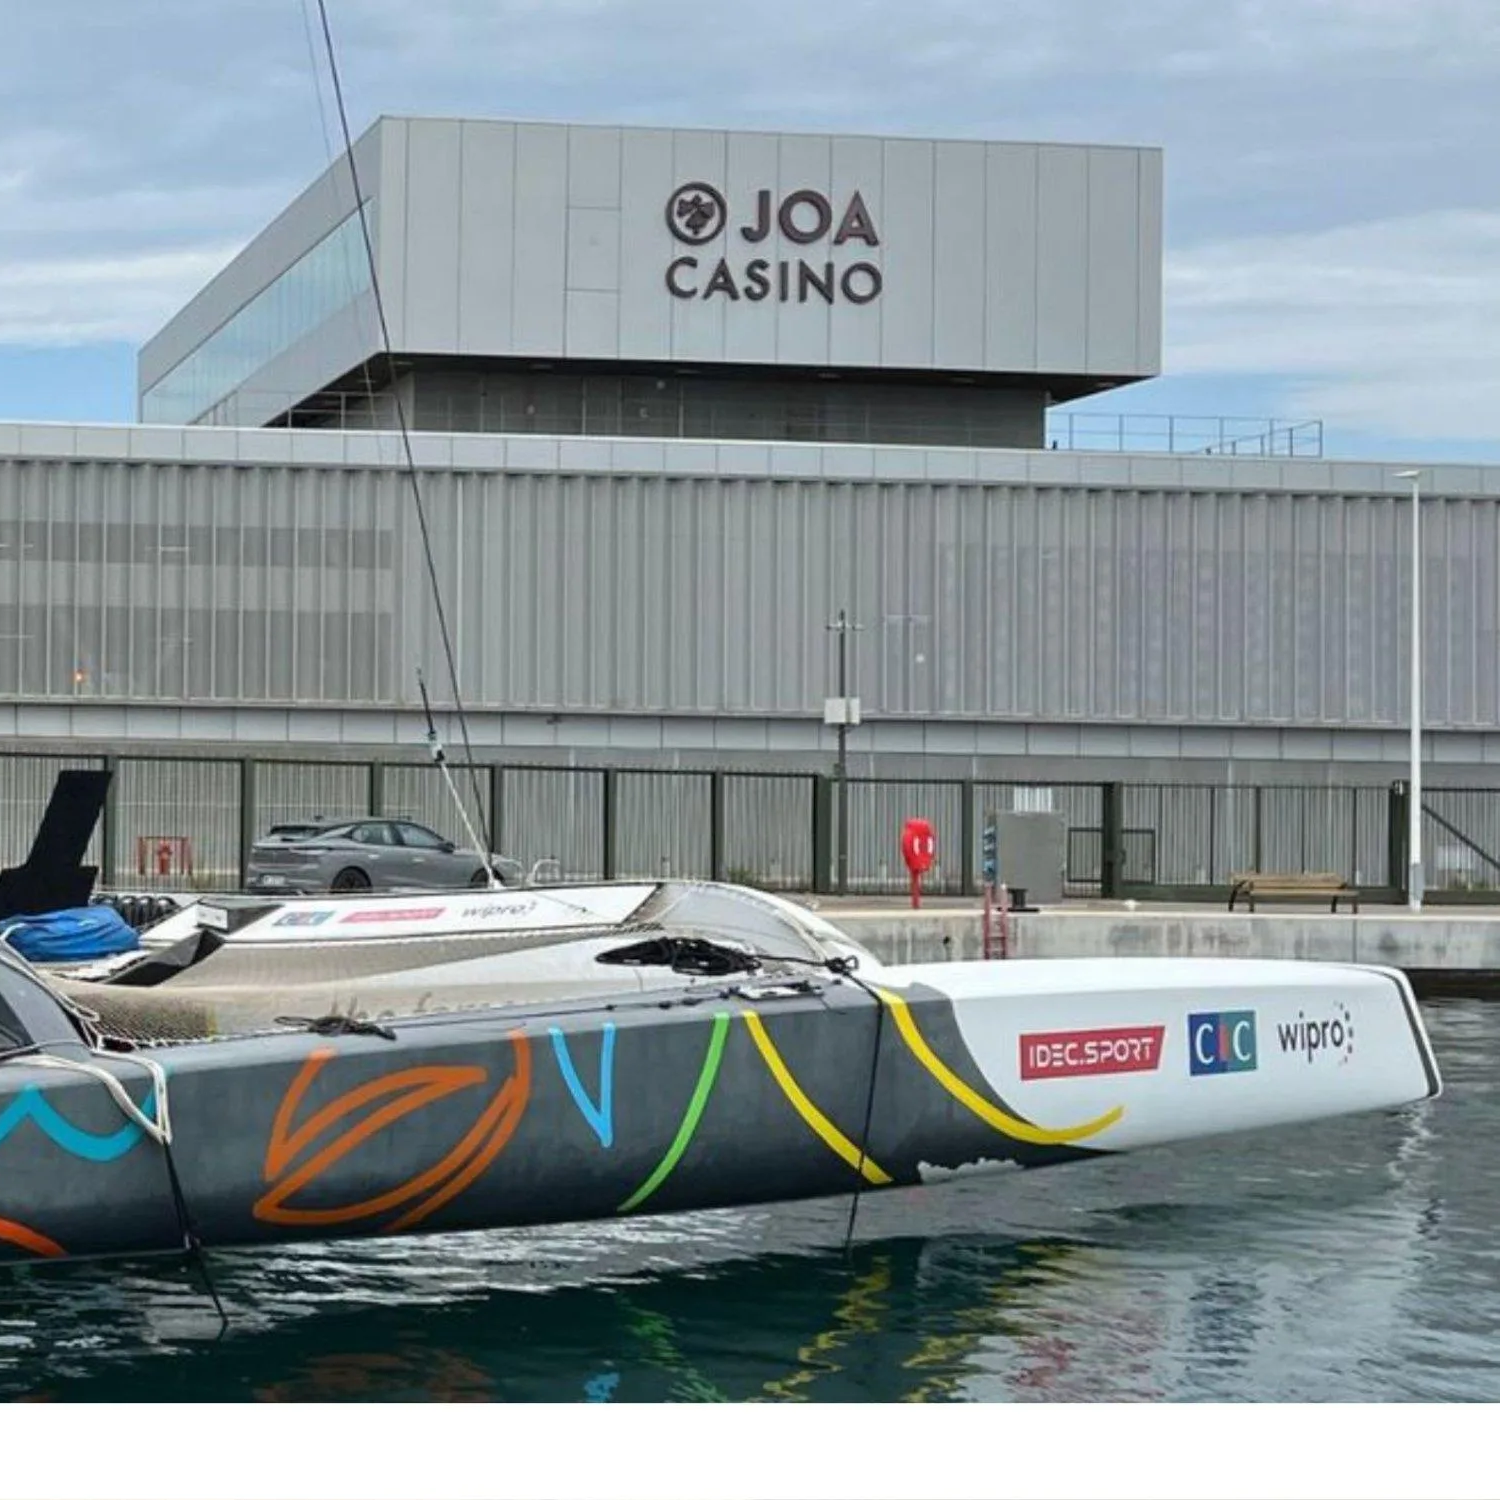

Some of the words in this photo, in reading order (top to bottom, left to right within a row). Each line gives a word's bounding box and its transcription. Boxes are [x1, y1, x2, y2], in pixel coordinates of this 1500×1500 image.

[740, 188, 880, 246] JOA
[664, 256, 883, 305] CASINO
[1194, 1018, 1252, 1066] CIC
[1277, 1008, 1345, 1065] wipro
